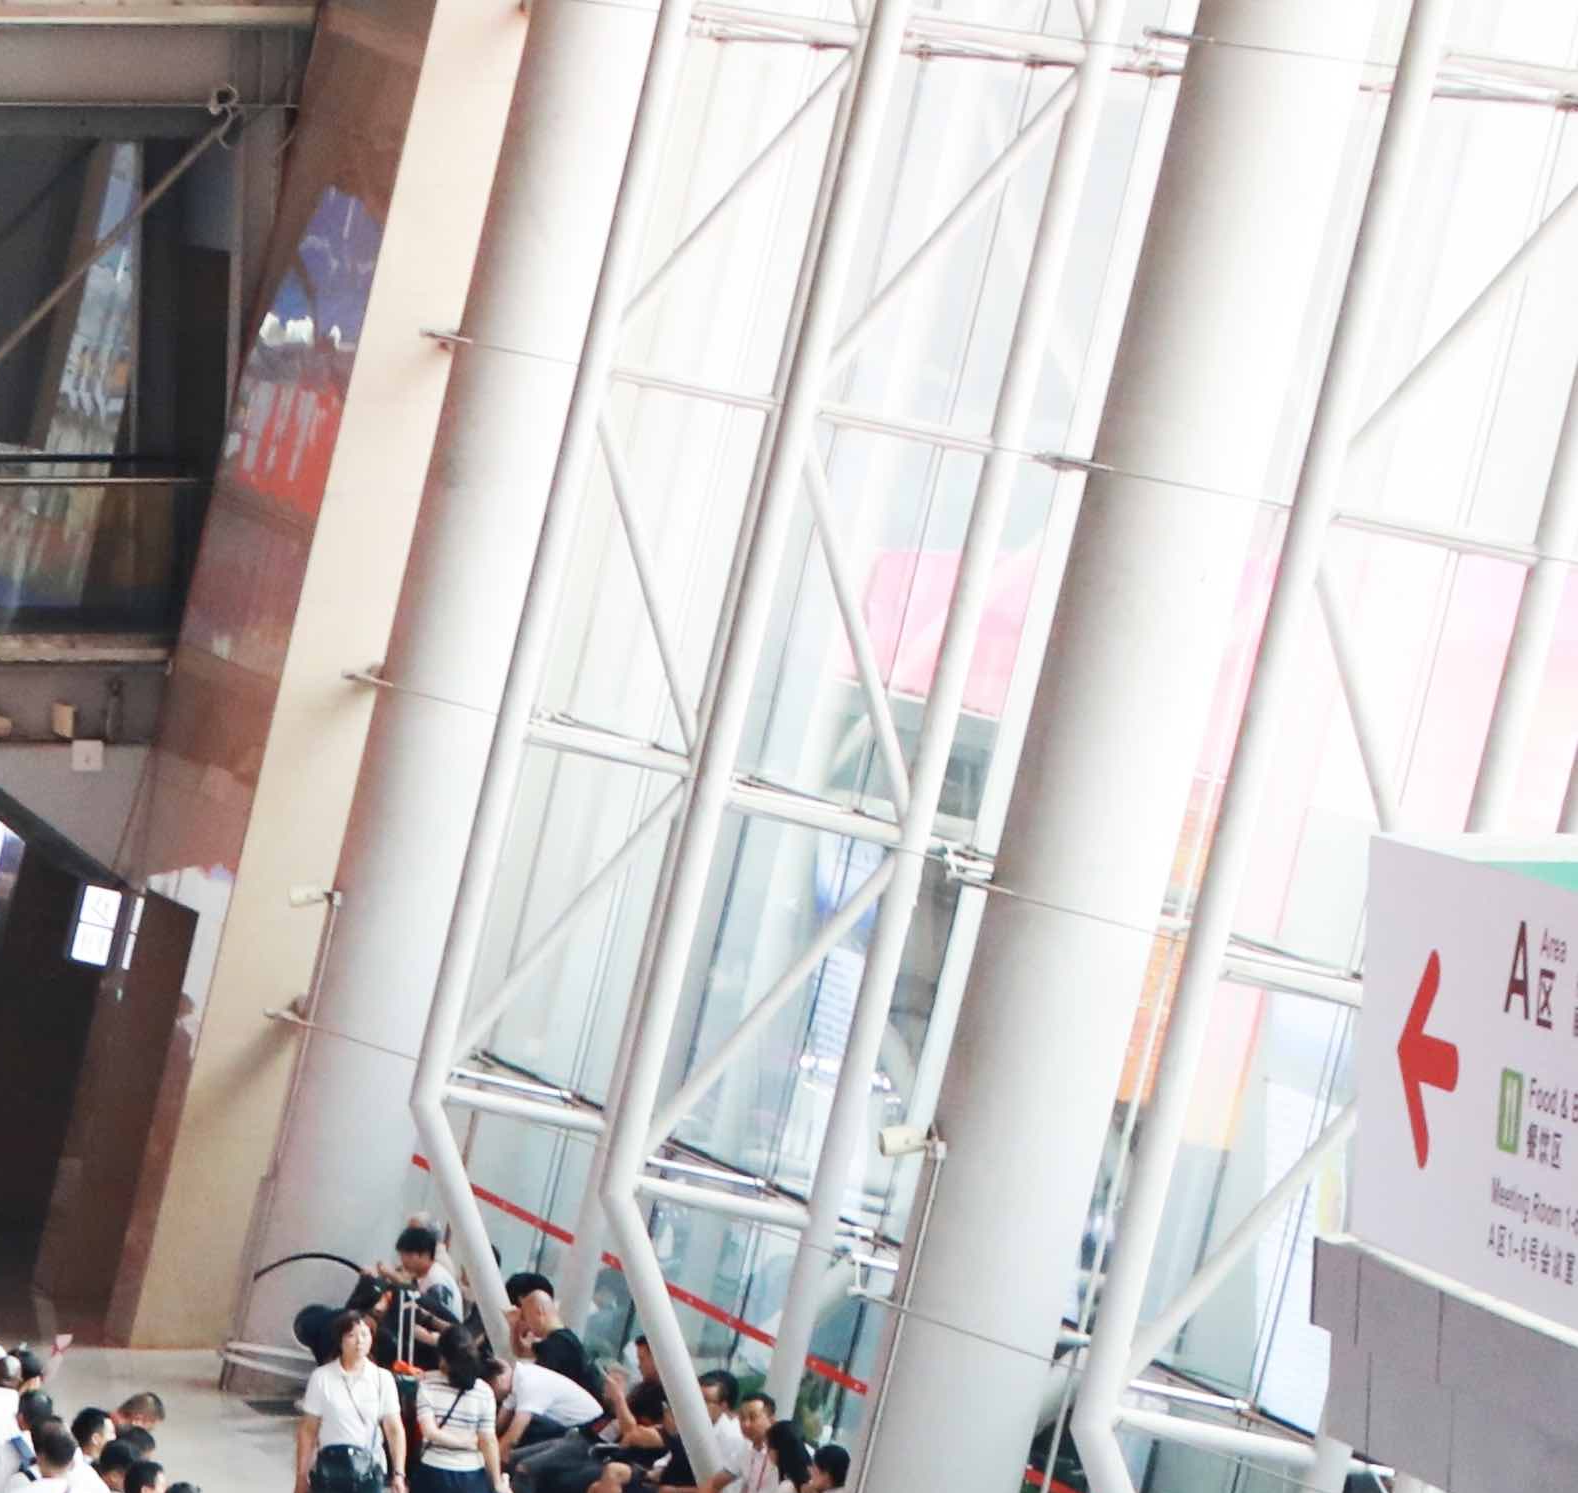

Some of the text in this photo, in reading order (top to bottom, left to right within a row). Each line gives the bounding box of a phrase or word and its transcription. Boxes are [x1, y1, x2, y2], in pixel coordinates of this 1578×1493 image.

[1505, 920, 1567, 1020] A Area
[1536, 968, 1556, 1029] 区
[1528, 1077, 1558, 1116] Food
